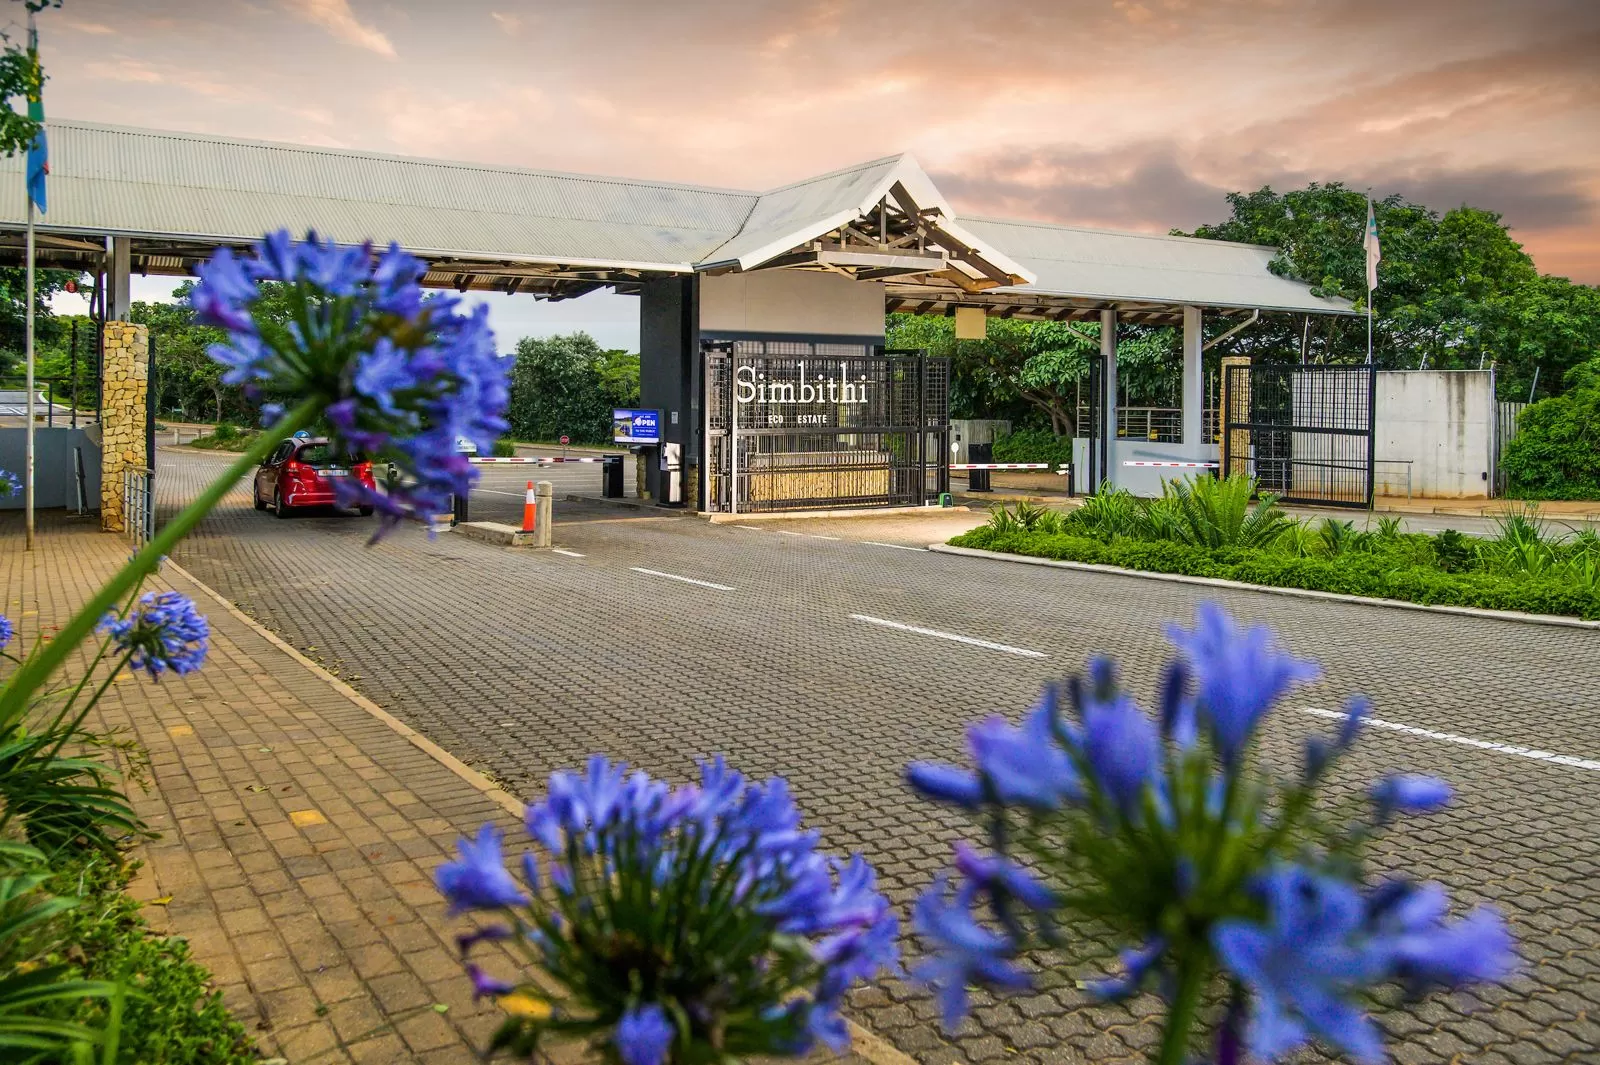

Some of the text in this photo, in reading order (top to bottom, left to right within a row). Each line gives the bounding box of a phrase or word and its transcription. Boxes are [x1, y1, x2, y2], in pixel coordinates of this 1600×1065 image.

[737, 361, 868, 403] Simbithi
[768, 414, 828, 424] ECO ESTATE
